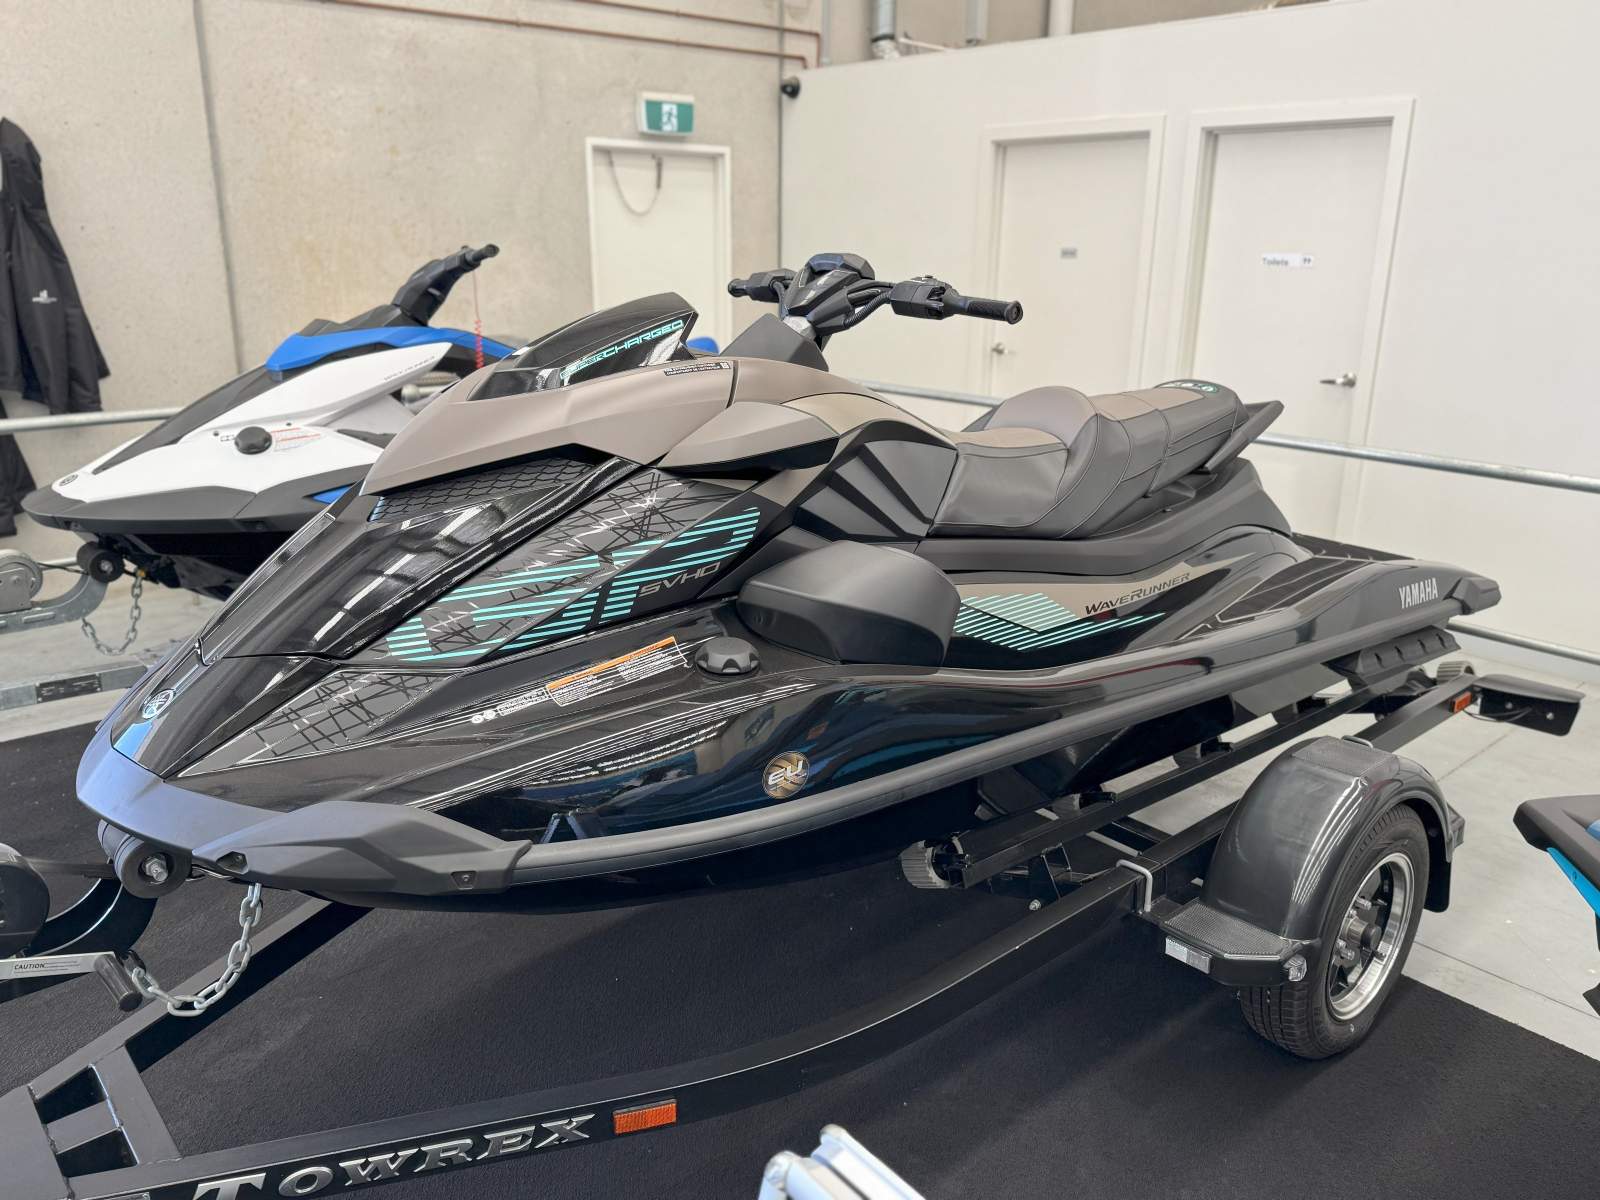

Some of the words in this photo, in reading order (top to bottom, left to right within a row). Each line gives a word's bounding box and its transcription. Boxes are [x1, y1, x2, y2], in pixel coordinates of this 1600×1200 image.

[638, 561, 721, 598] SVHO
[1398, 577, 1439, 609] YAMAHA
[14, 962, 46, 970] CAUTION
[192, 1113, 596, 1200] TOWREX
